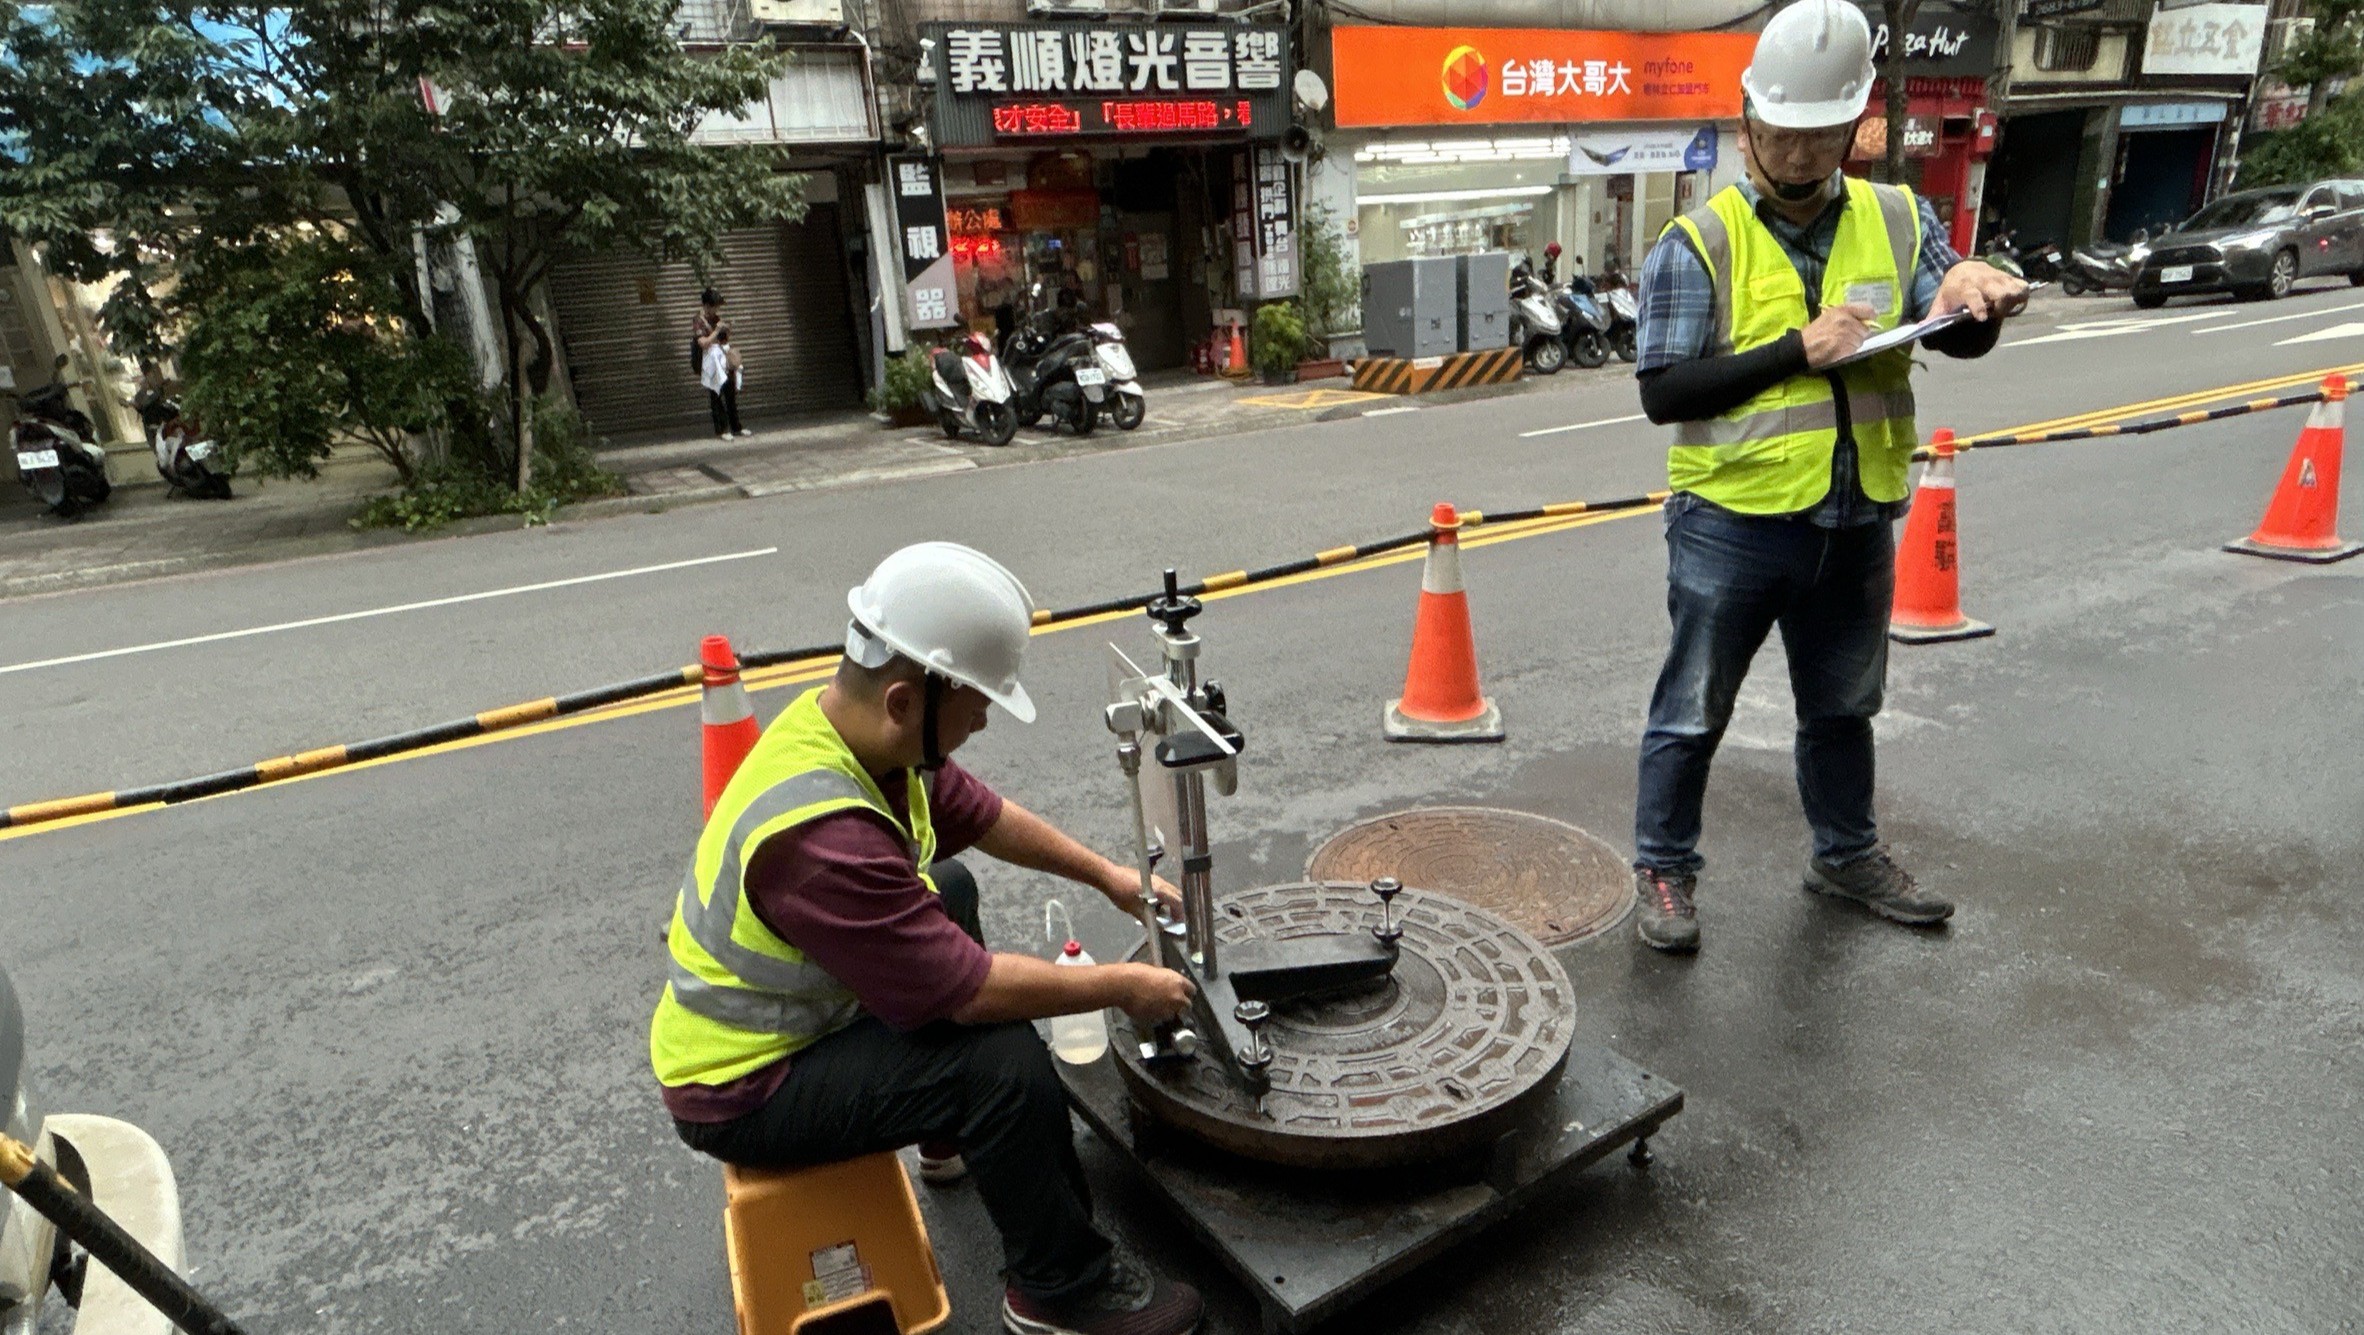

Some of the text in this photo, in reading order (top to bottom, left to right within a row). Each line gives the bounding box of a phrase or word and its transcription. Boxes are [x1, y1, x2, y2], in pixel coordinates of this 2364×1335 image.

[947, 30, 1281, 91] 義順燈光音響
[1929, 26, 1970, 57] Hut
[1502, 59, 1631, 97] 台灣大哥大
[1644, 57, 1694, 77] myfone
[899, 163, 946, 320] 監視器
